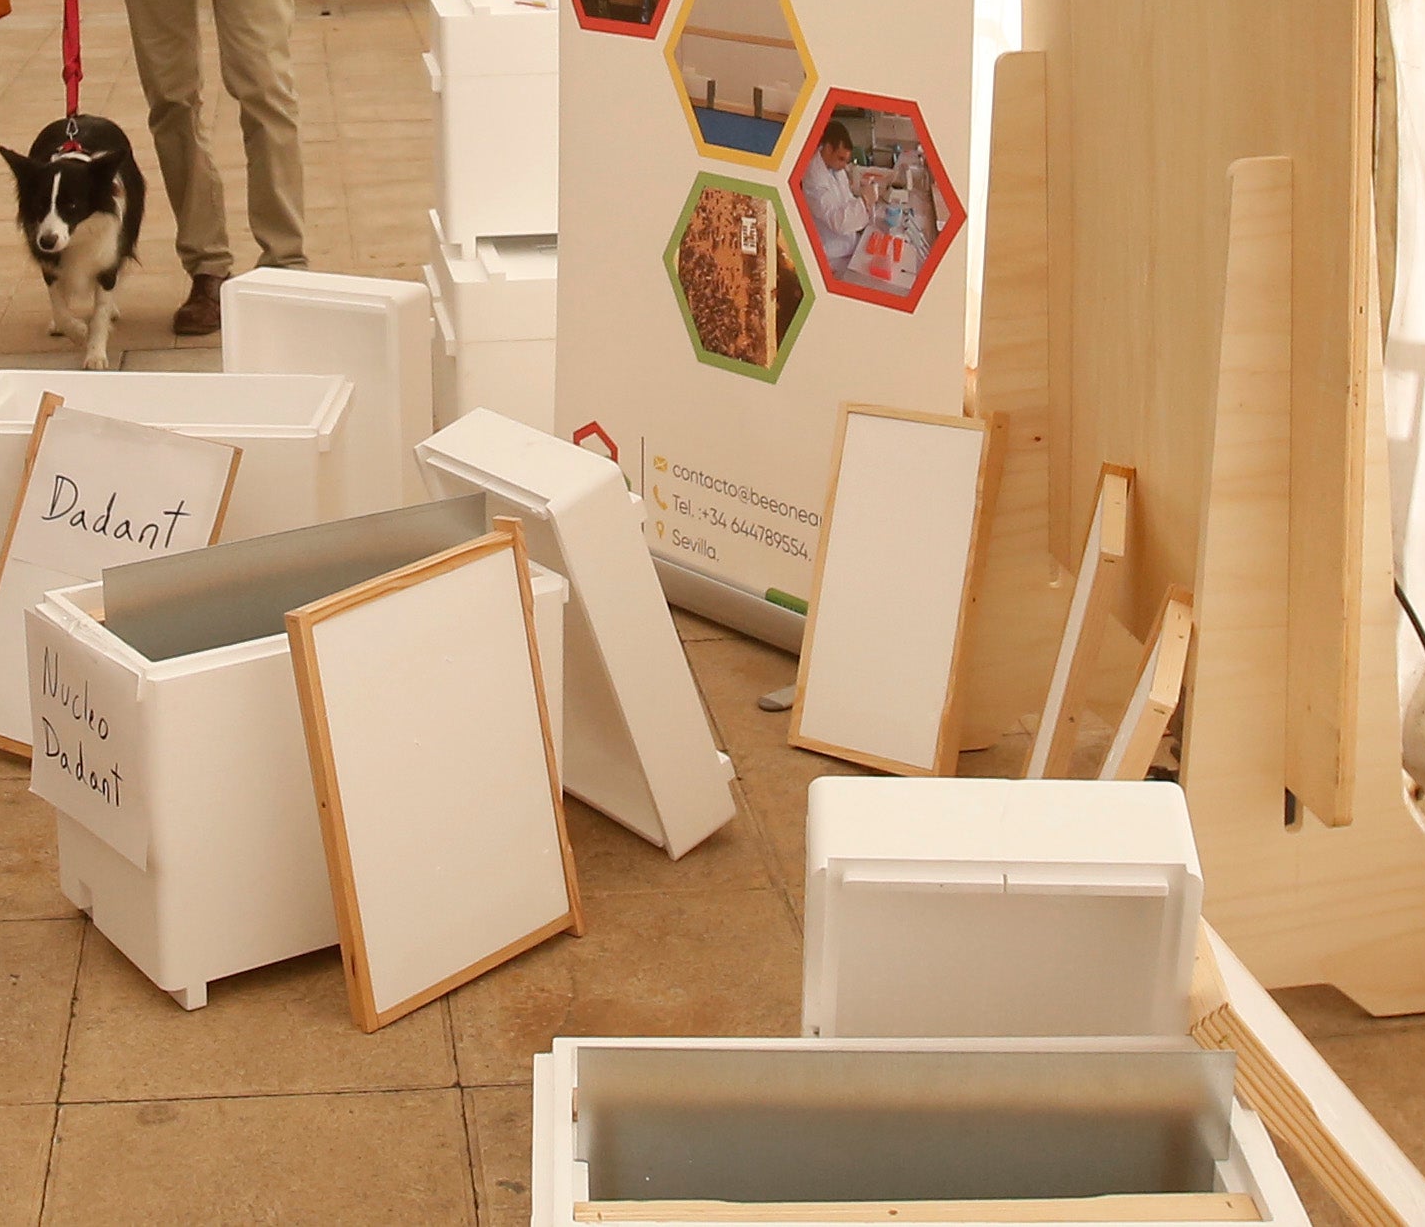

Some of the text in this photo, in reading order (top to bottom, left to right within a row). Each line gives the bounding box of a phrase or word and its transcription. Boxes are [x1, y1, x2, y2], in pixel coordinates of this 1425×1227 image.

[41, 474, 191, 550] Dadant
[672, 494, 695, 517] Tel.
[731, 517, 812, 562] 644789554.
[672, 529, 720, 562] Sevilla.
[41, 646, 110, 741] Nucleo
[41, 716, 123, 808] Dadant
